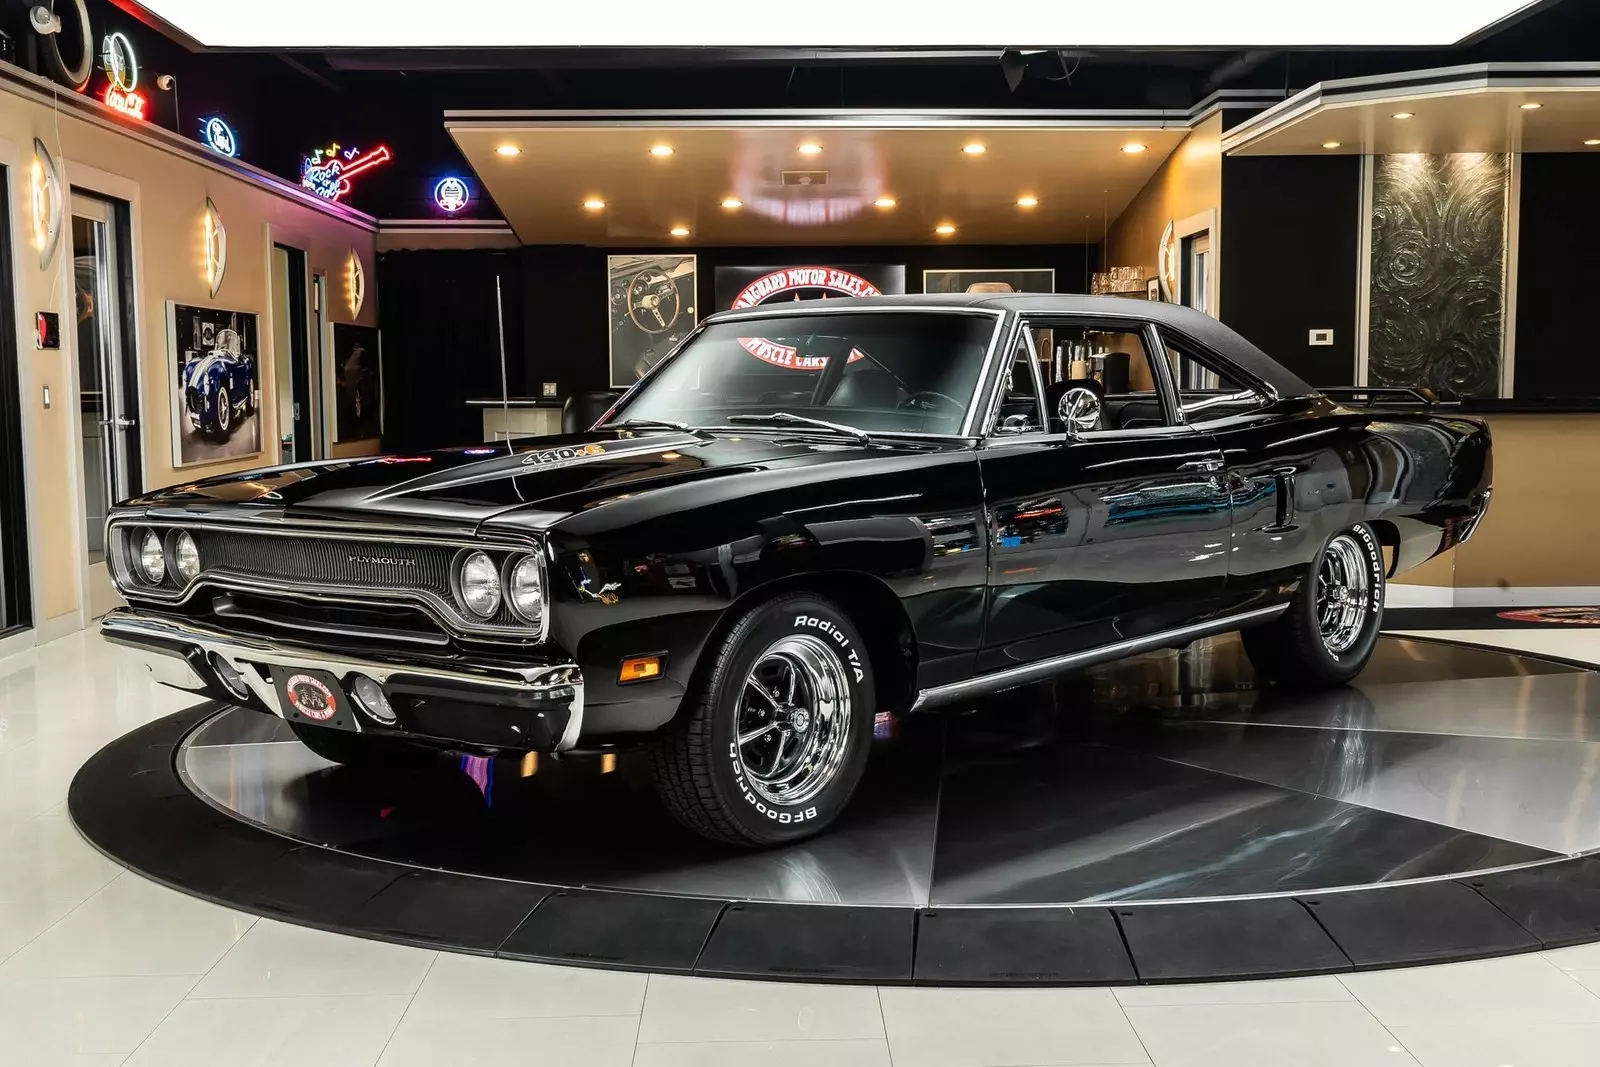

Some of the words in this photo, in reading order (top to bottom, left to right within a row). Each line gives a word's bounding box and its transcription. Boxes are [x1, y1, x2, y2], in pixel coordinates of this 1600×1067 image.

[310, 163, 340, 183] Rock
[735, 272, 788, 310] ANGUARD
[787, 269, 827, 286] MOTOR
[747, 338, 794, 366] MUSCLE
[348, 555, 416, 566] PLYMOUTH
[1352, 524, 1381, 613] BFGoodrich
[794, 615, 850, 648] Radial
[848, 648, 864, 684] T/A
[729, 742, 818, 824] BFGoodrich
